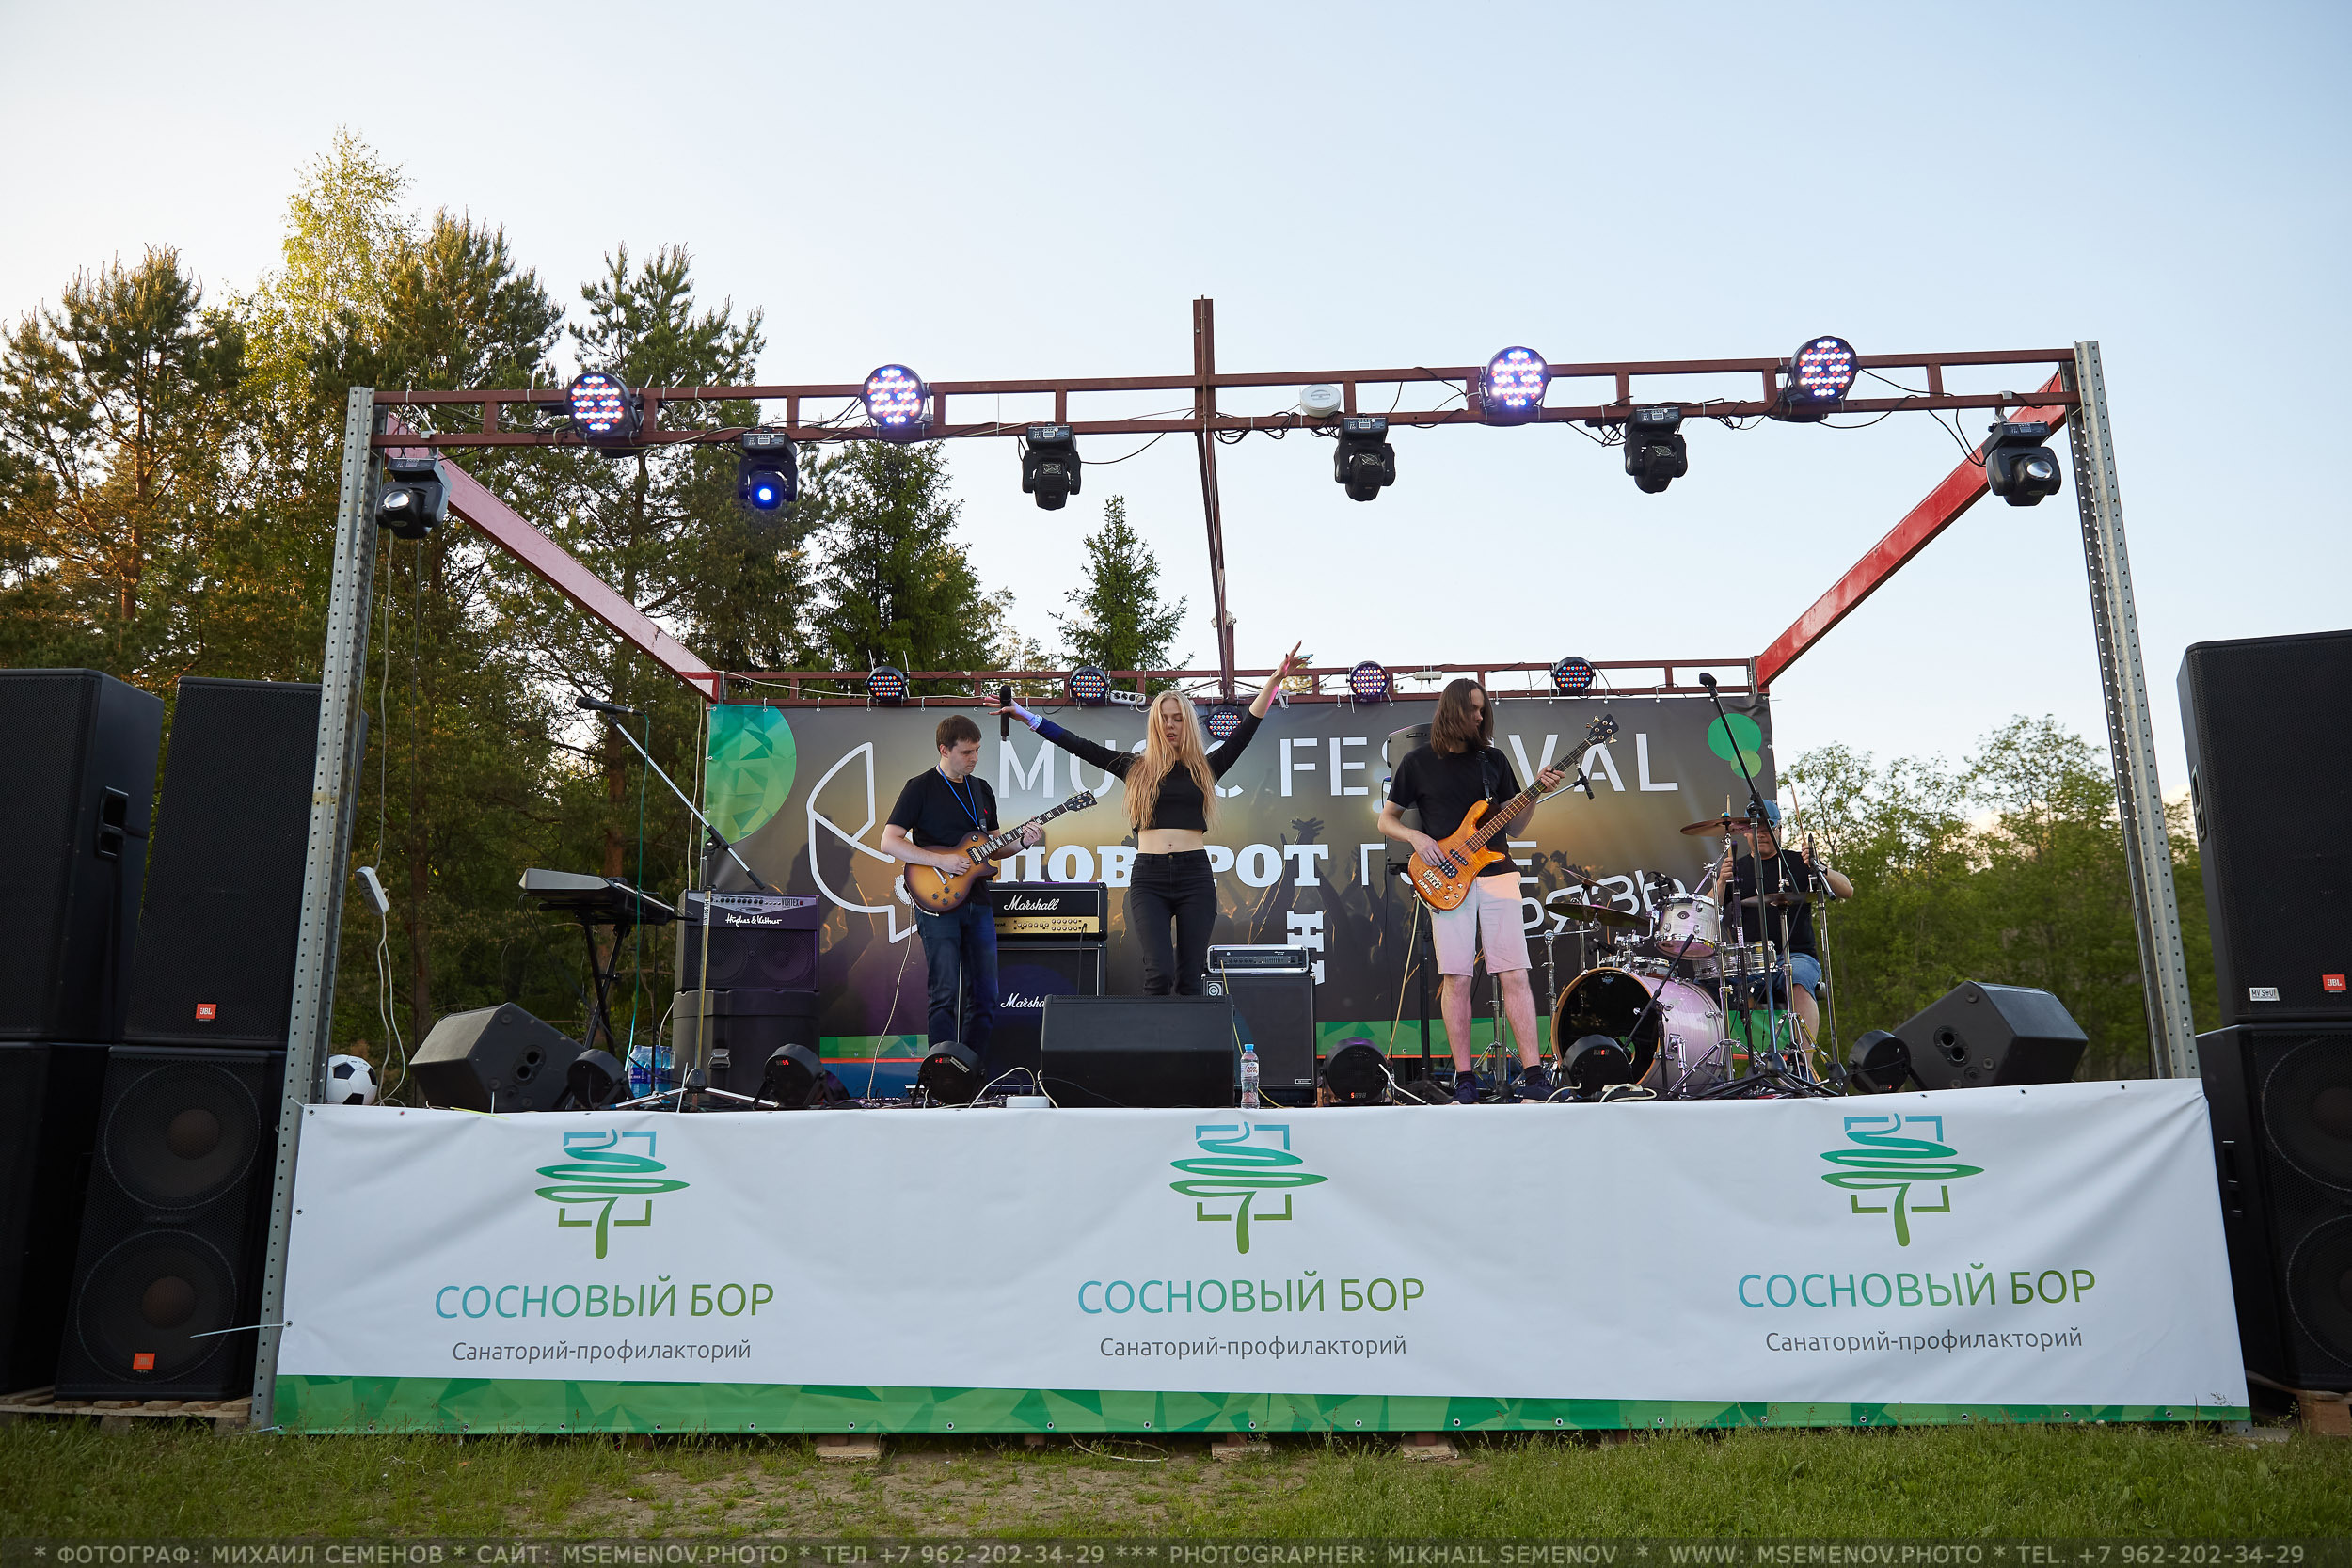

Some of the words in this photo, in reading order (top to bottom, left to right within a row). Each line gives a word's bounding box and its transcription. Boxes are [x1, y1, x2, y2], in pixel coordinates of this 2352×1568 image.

[1280, 734, 1678, 797] FEVAL
[1003, 895, 1060, 911] Marshall
[2327, 978, 2343, 987] JBL
[1000, 993, 1045, 1008] Marsha
[436, 1275, 675, 1319] СОСНОВЫЙ
[691, 1283, 773, 1317] БОР
[1078, 1270, 1325, 1314] СОСНОВЫЙ
[1341, 1277, 1424, 1312] БОР
[1739, 1263, 1995, 1308] СОСНОВЫЙ
[2010, 1269, 2096, 1305] БОР
[453, 1339, 751, 1364] Санаторий-профилакторий
[1100, 1335, 1406, 1360] Санаторий-профилакторий
[1766, 1327, 2082, 1354] Санаторий-профилакторий
